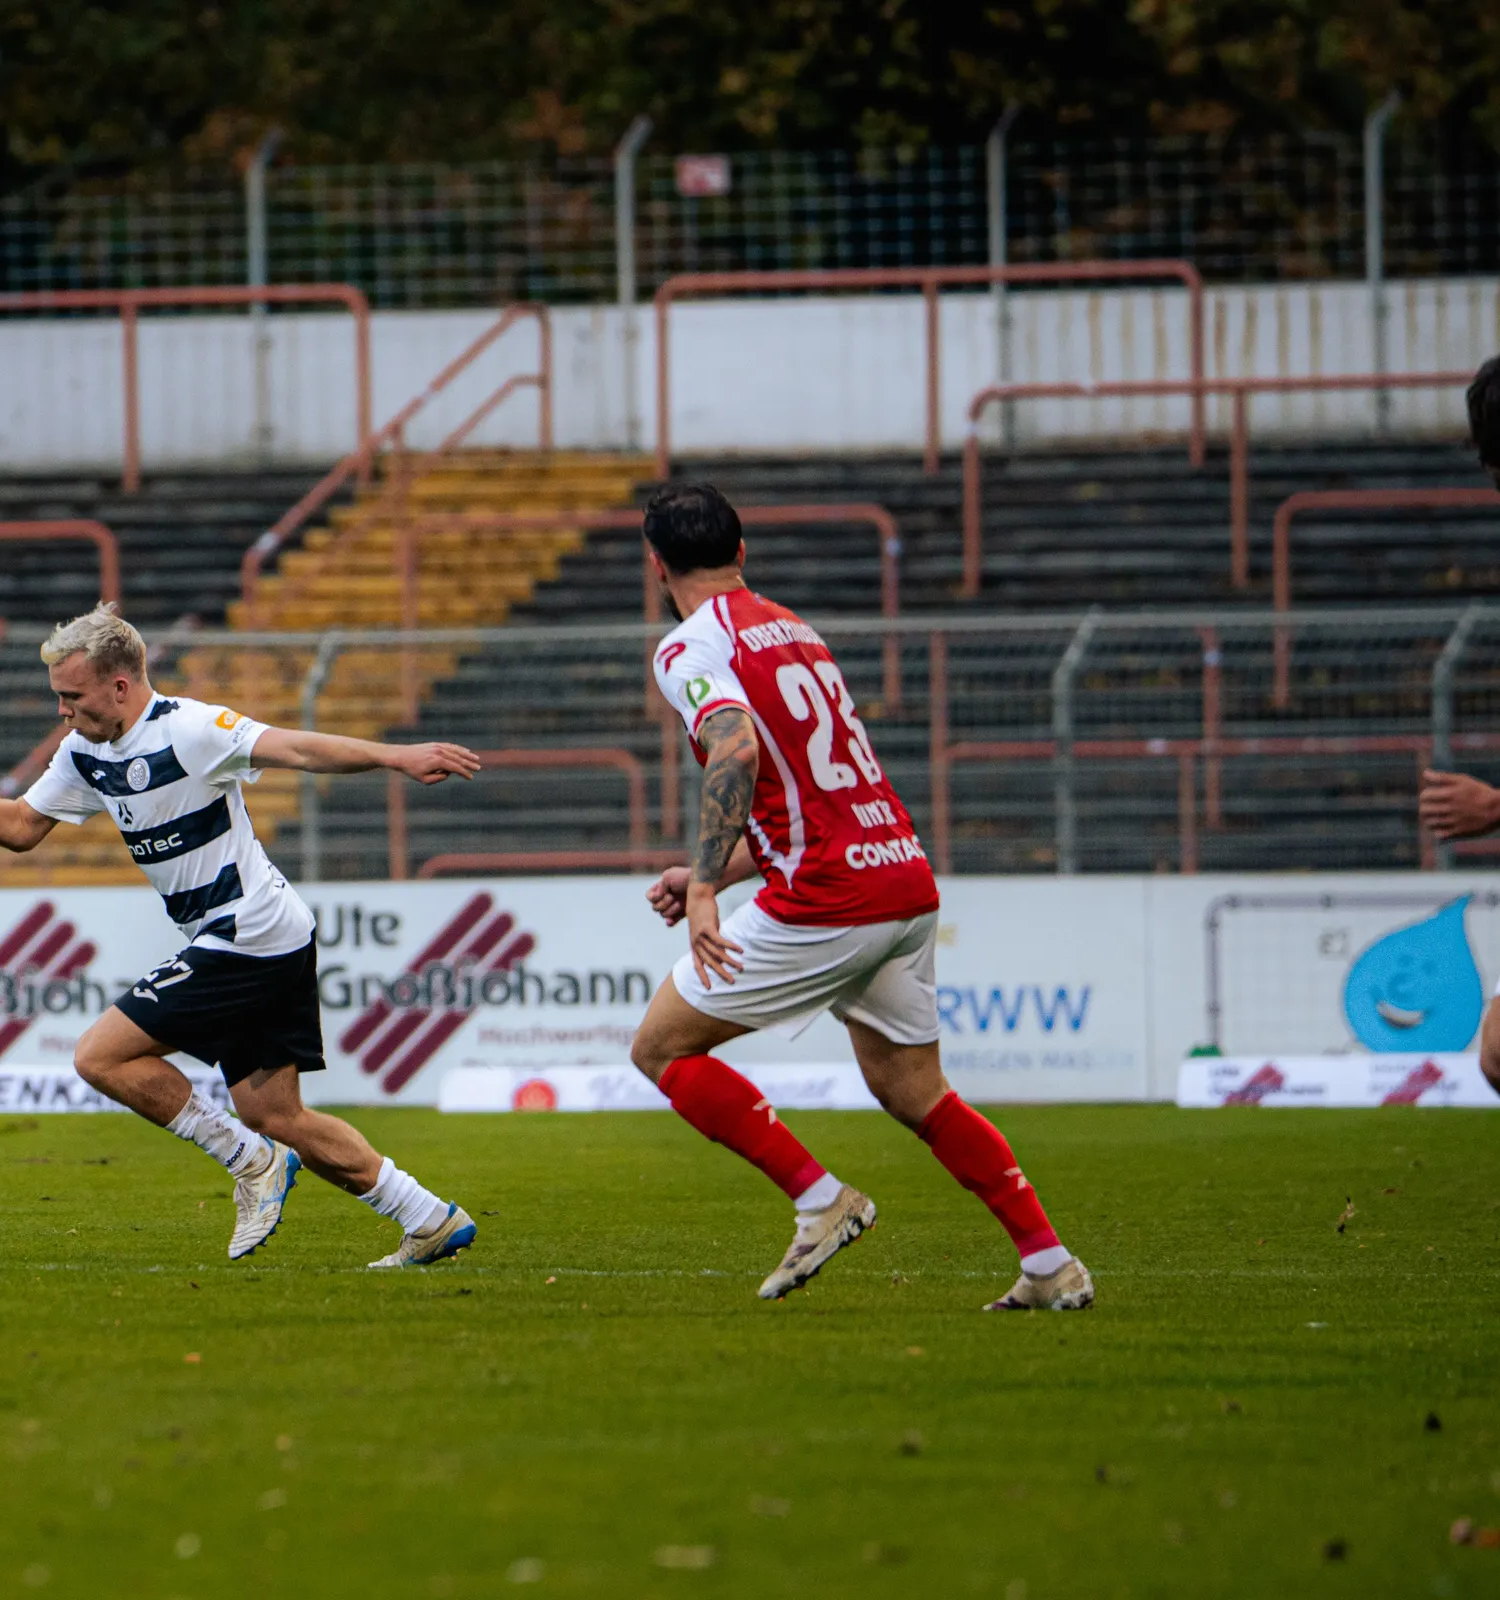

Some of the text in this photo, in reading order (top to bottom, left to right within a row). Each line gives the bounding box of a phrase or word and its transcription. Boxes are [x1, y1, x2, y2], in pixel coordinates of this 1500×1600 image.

[776, 660, 882, 792] 23
[313, 902, 399, 948] Ute
[318, 953, 652, 1009] Großjohann
[938, 984, 1094, 1034] RWW
